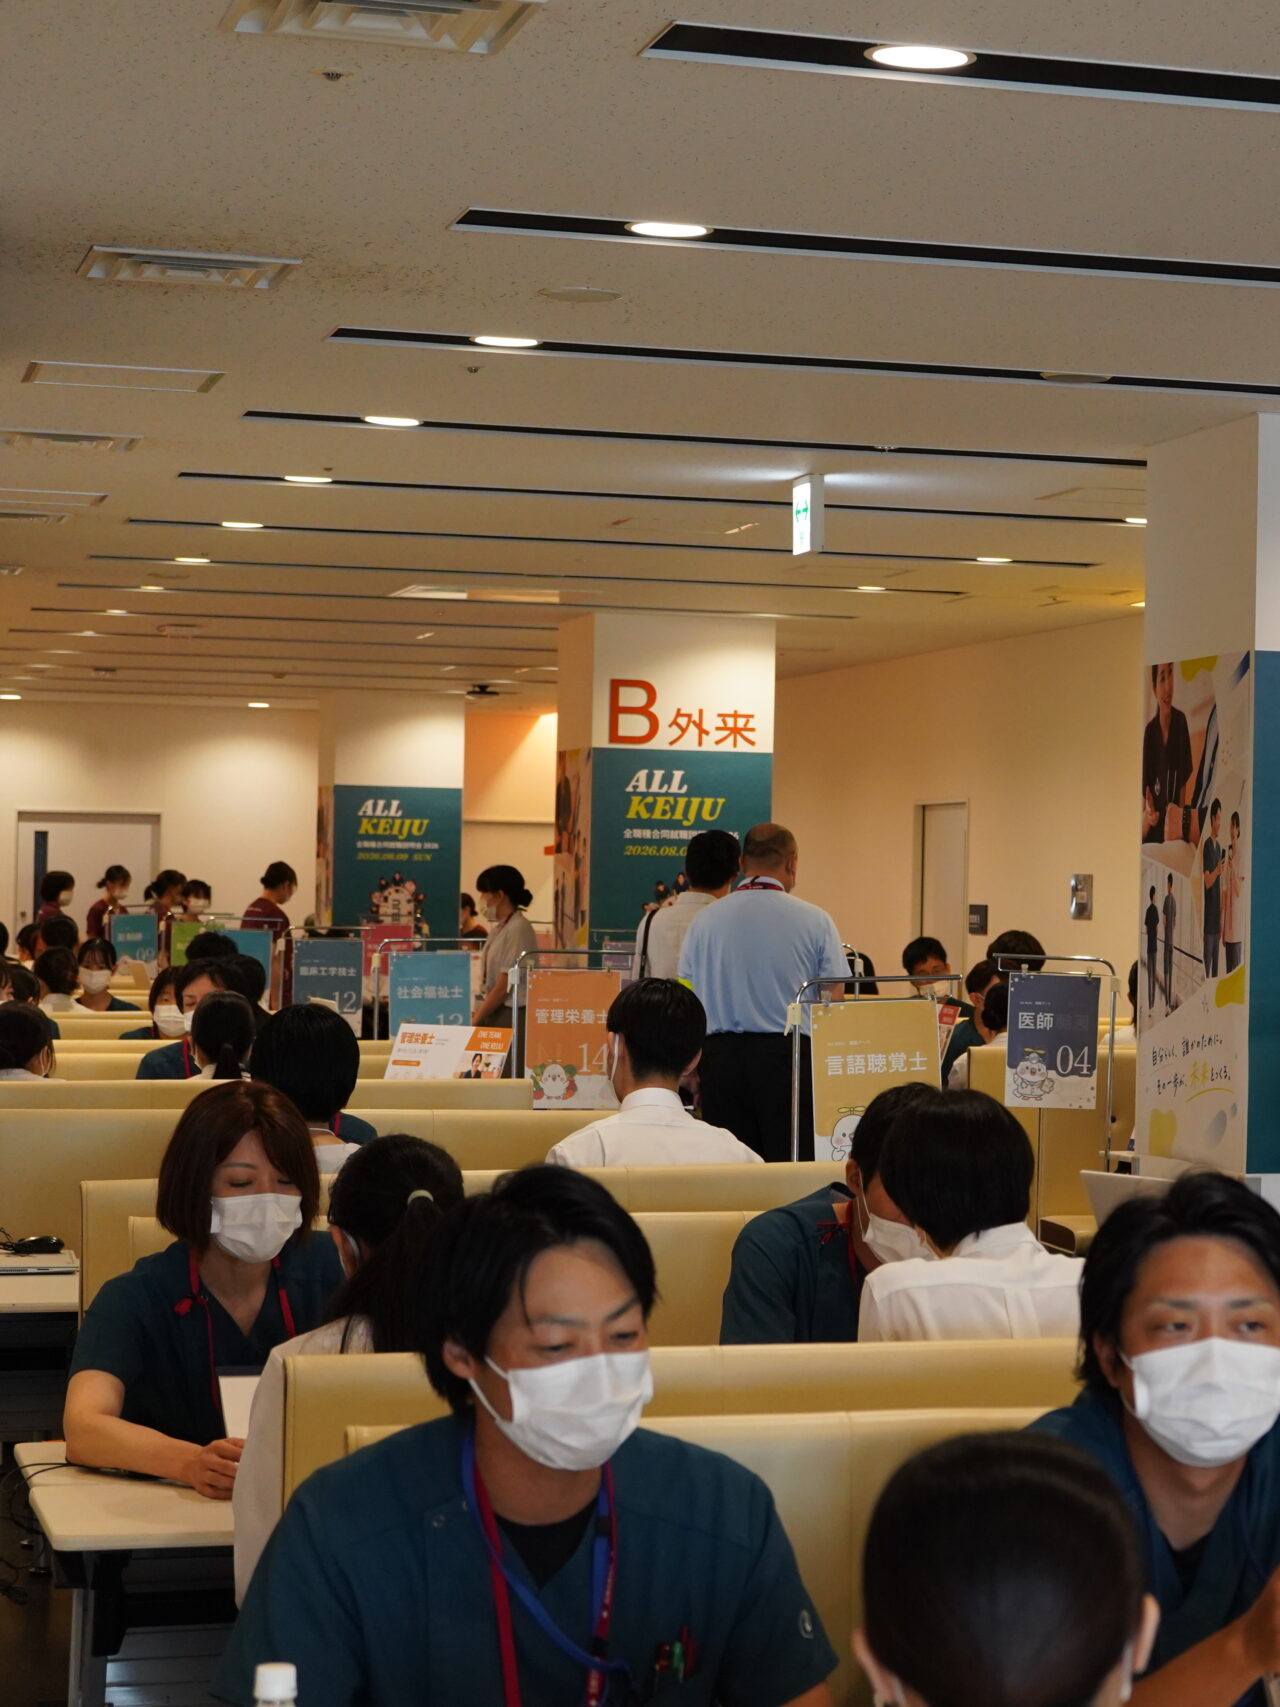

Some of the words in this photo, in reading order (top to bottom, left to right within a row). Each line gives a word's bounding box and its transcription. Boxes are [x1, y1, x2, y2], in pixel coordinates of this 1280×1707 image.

[608, 678, 660, 745] B
[668, 708, 757, 748] 外来
[625, 769, 688, 793] ALL
[357, 799, 402, 817] ALL
[625, 795, 726, 826] KEIJU
[358, 817, 430, 839] KEIJU
[623, 845, 688, 856] 2026.08.0
[332, 991, 358, 1013] 12
[396, 985, 464, 999] 社会福祉士
[535, 1008, 609, 1025] 管理栄養士
[1018, 1011, 1055, 1031] 医師
[578, 1042, 610, 1074] 14
[825, 1051, 929, 1076] 言語聴覚士
[1056, 1044, 1092, 1076] 04
